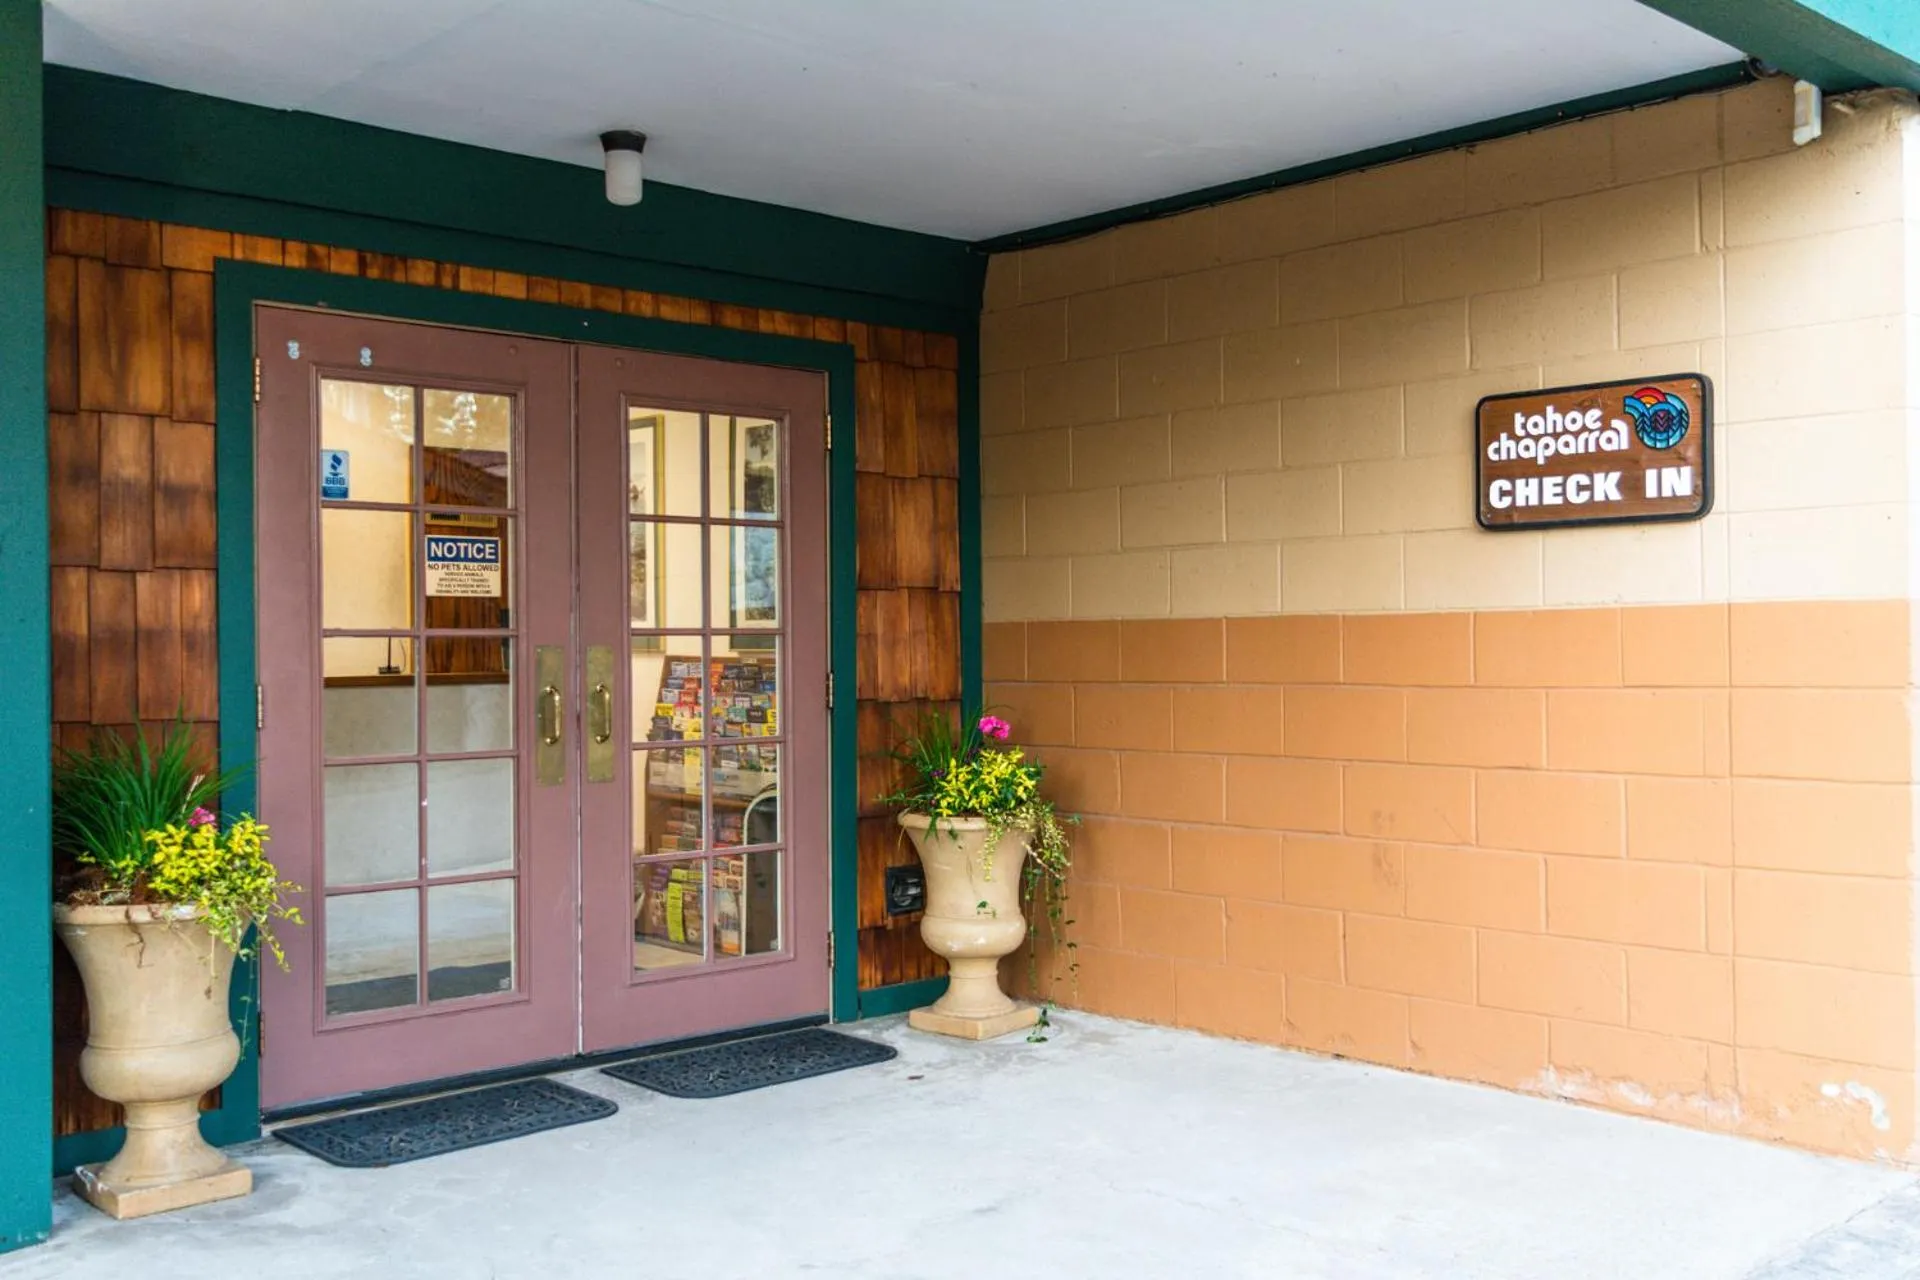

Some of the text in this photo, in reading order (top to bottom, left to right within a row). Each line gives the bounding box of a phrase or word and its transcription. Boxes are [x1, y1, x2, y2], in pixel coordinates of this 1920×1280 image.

[1514, 405, 1603, 437] tahoe
[1487, 419, 1630, 465] chaparral
[1489, 465, 1694, 509] CHECK IN
[430, 541, 496, 559] NOTICE
[428, 563, 499, 572] NO PETS ALLOWED
